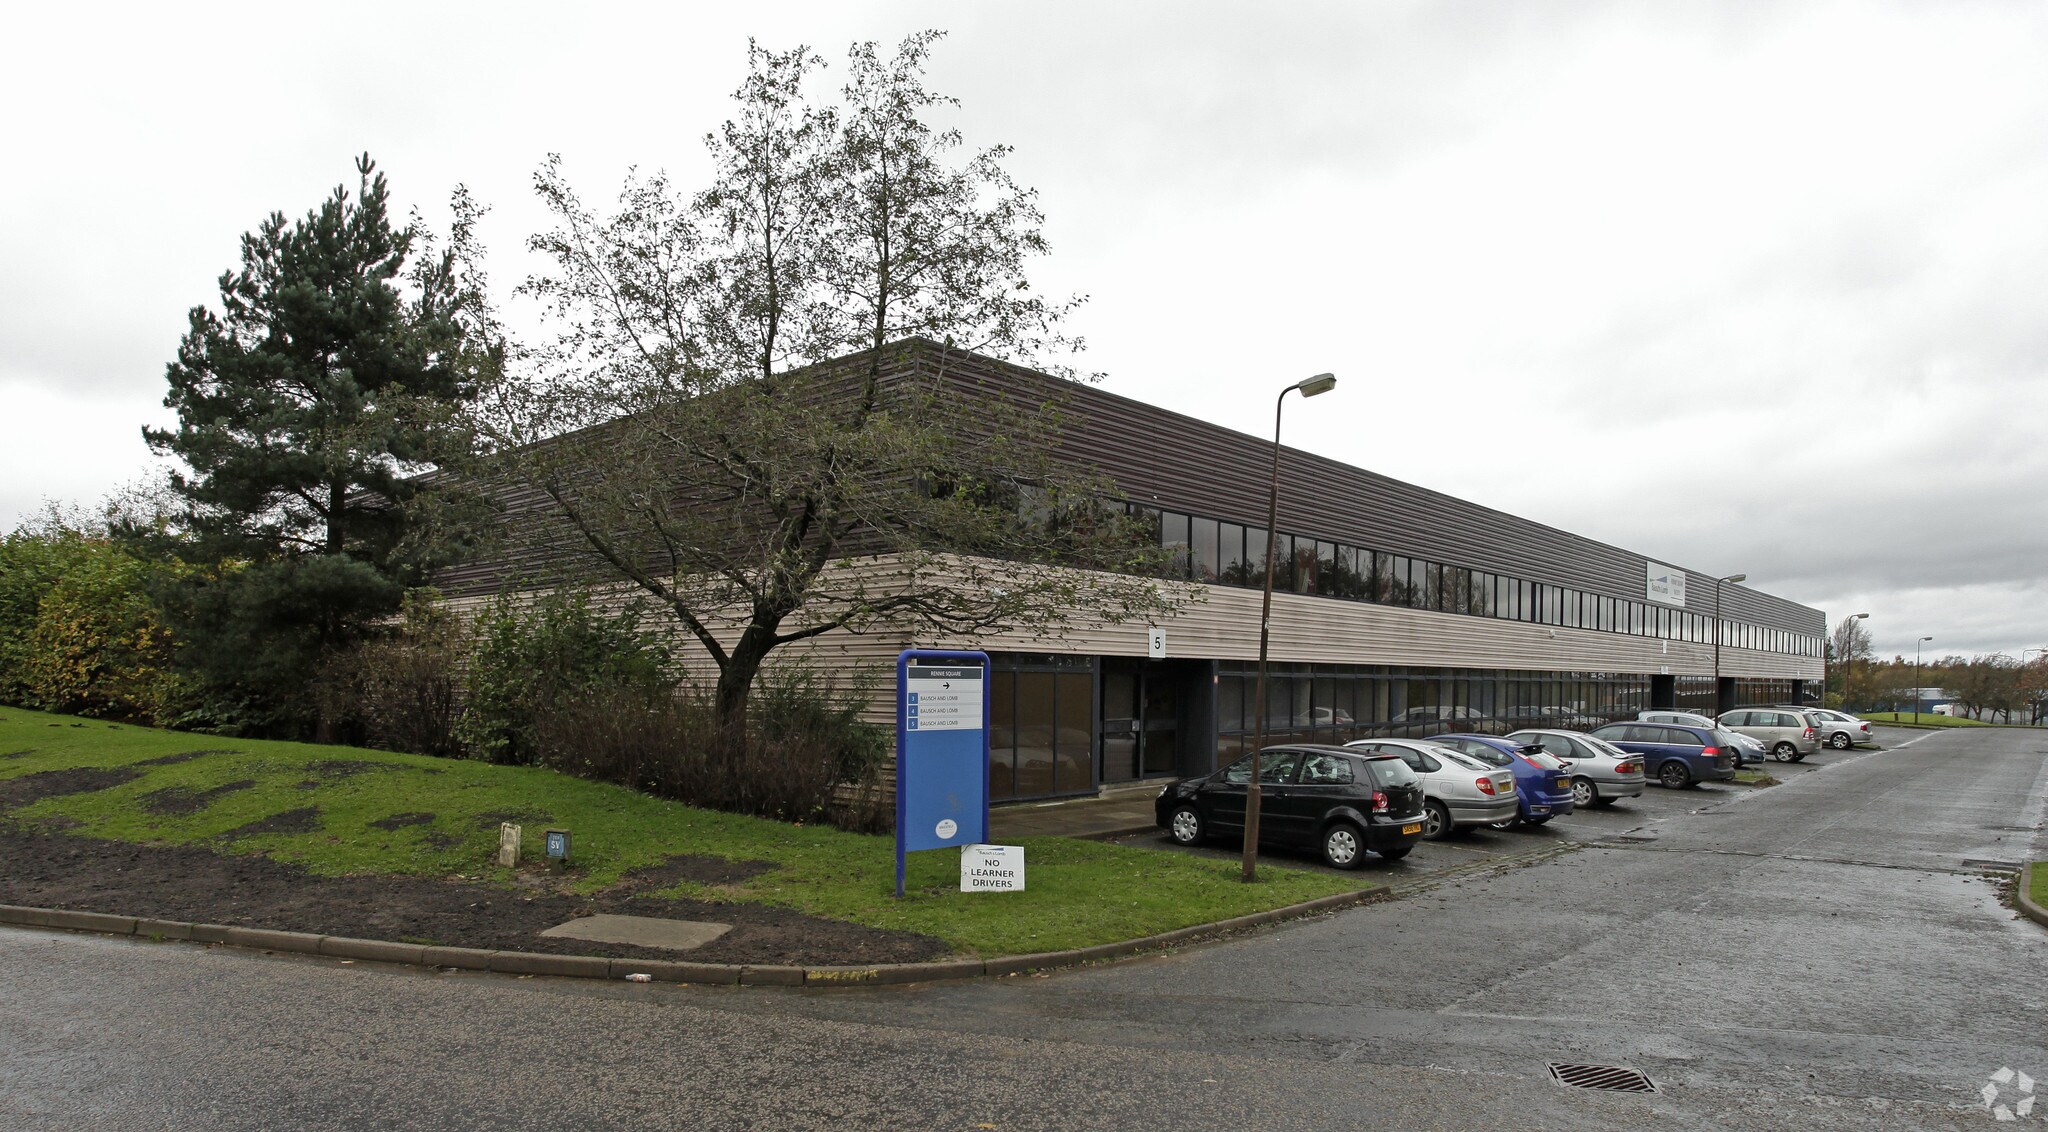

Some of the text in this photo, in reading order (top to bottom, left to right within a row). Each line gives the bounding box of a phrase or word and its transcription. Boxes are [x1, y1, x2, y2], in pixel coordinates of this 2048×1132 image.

[1154, 636, 1161, 650] 5
[984, 859, 1000, 867] NO
[970, 868, 1014, 877] LEARNER
[972, 879, 1013, 888] DRIVERS
